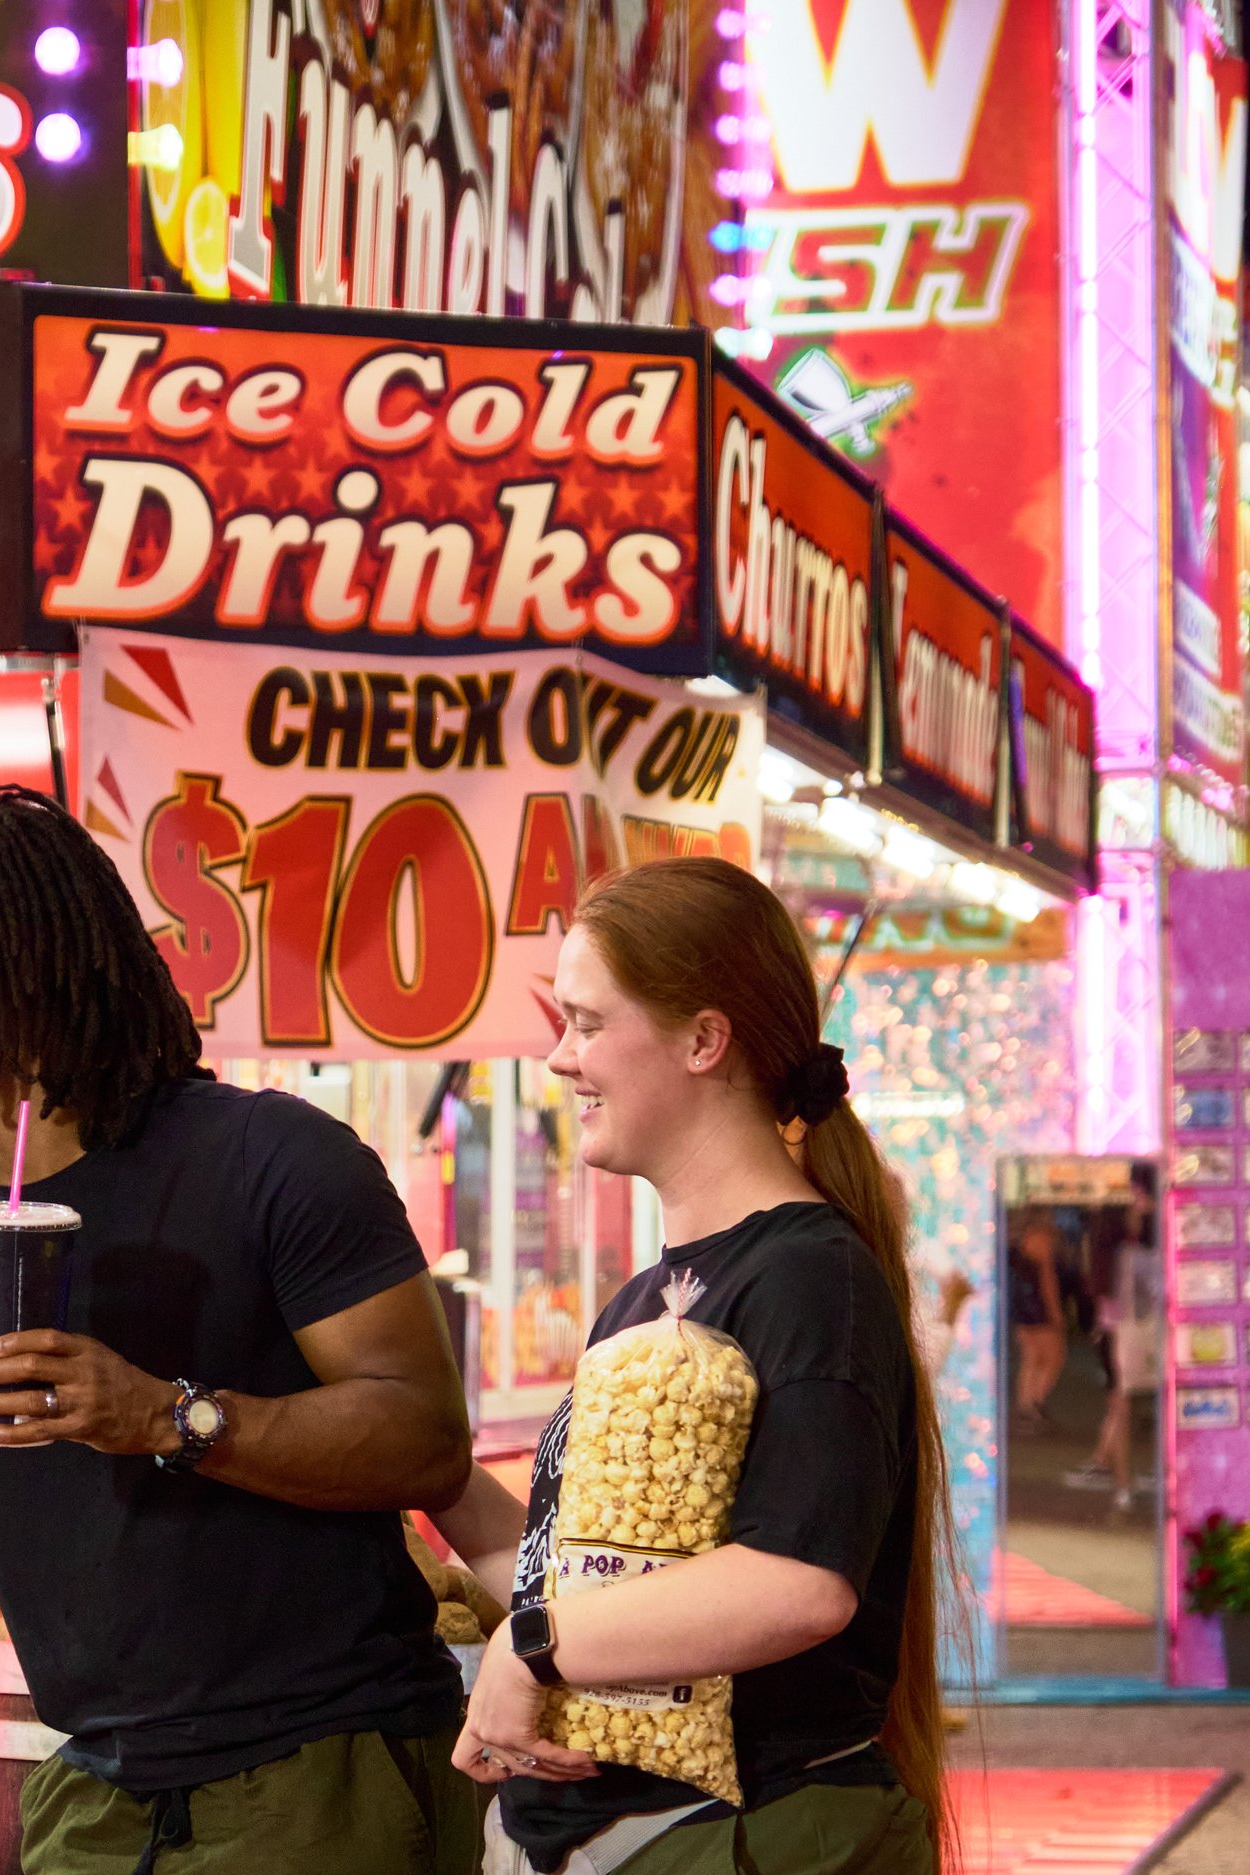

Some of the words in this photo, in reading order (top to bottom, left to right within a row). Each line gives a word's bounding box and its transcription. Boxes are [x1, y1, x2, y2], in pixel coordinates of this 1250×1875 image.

[63, 330, 304, 438] Ice
[341, 350, 680, 462] Cold
[44, 458, 684, 640] Drinks
[715, 413, 868, 722] Churros
[246, 665, 515, 771] CHECK
[634, 707, 741, 803] OUR
[142, 772, 495, 1051] $10
[582, 1554, 626, 1576] POP
